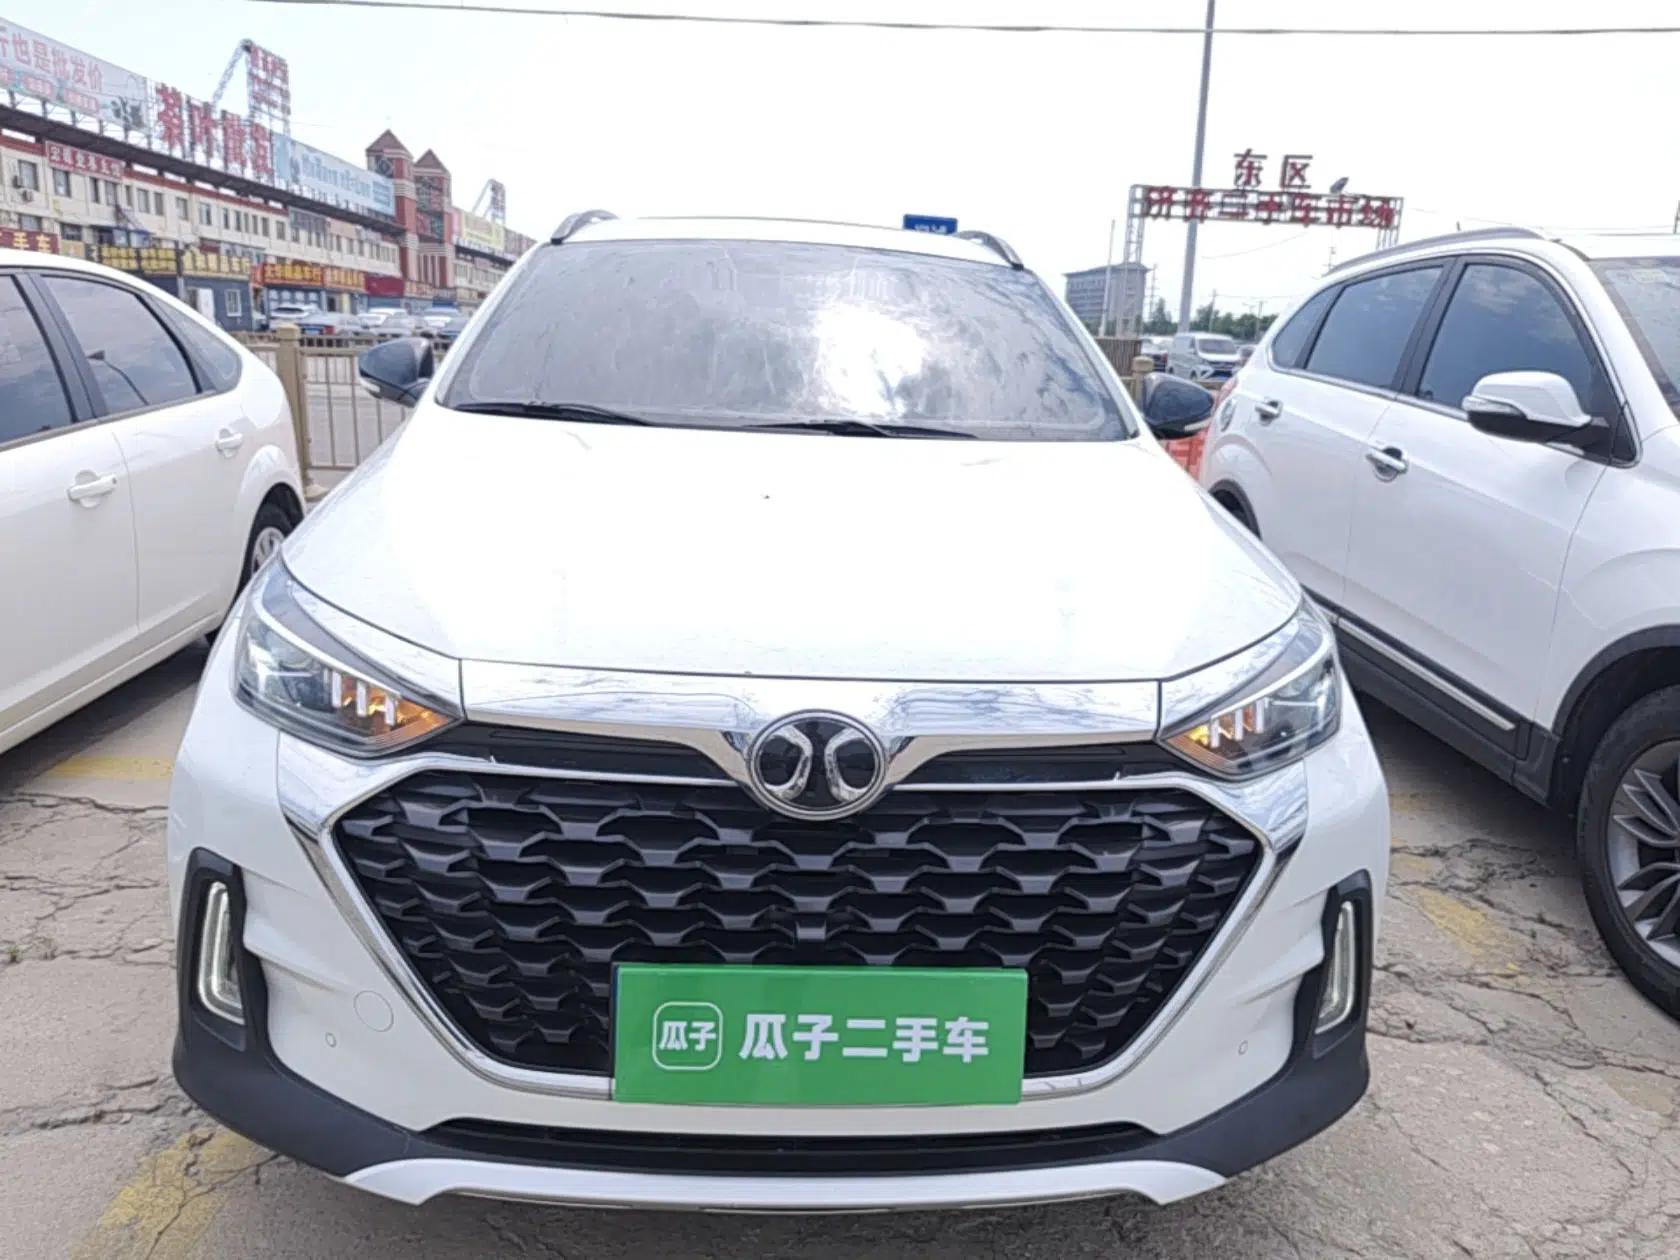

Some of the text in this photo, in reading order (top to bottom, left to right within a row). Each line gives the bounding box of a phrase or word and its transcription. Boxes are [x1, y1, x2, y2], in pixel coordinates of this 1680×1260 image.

[1233, 148, 1313, 188] 东区
[658, 1020, 717, 1051] 瓜子
[738, 1013, 990, 1063] 瓜子二手车
